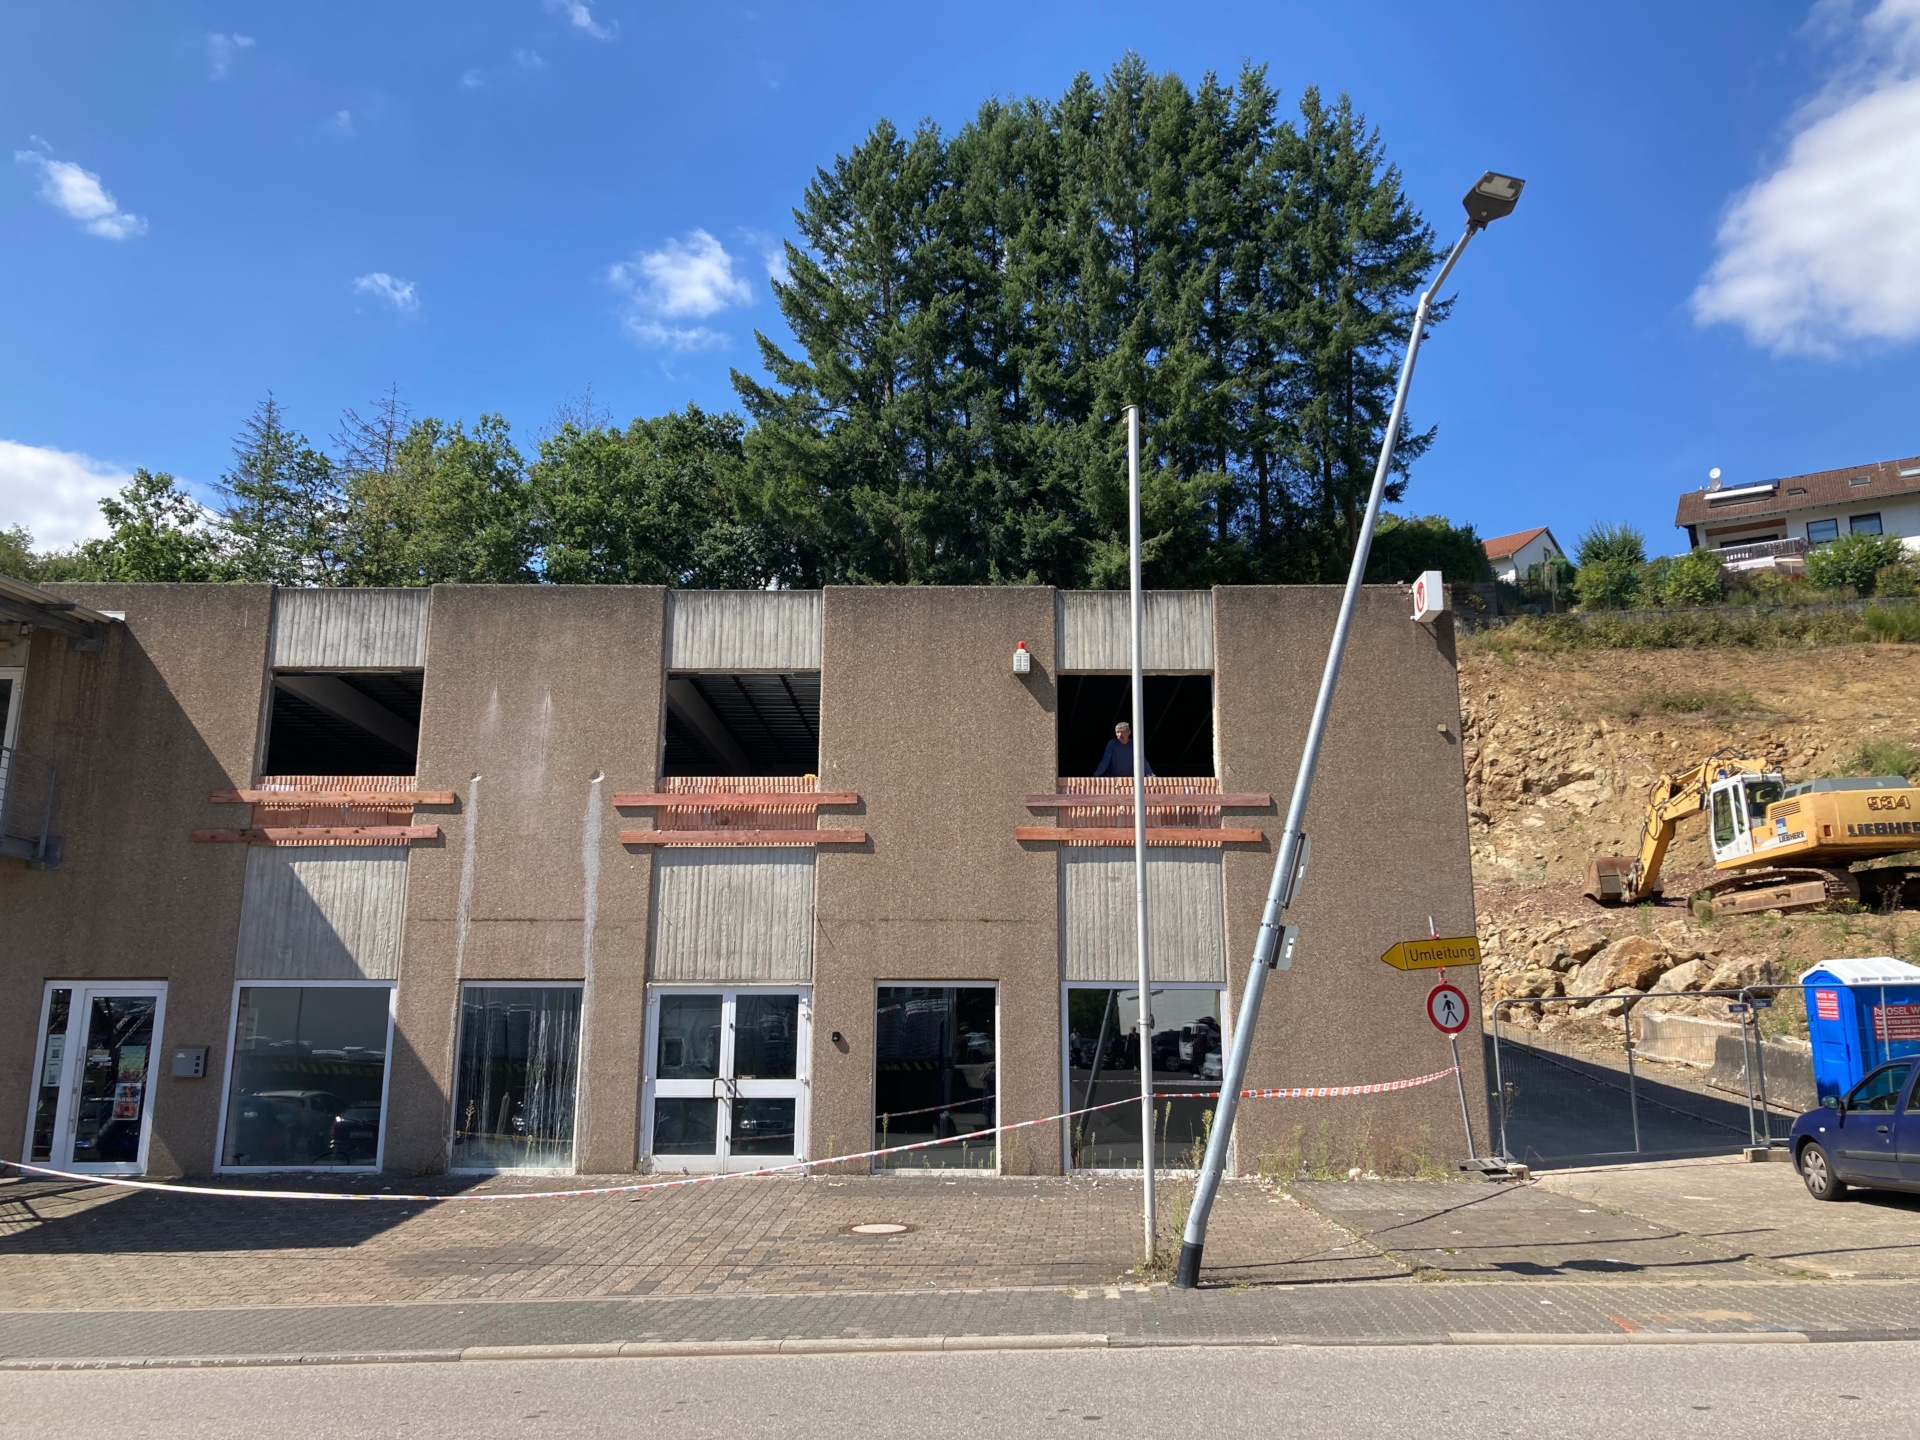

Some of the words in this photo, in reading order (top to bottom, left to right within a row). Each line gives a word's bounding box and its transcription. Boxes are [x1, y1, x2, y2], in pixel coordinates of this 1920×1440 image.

[1867, 795, 1911, 811] 934
[1779, 830, 1805, 843] LIEBHERR
[1408, 946, 1475, 962] Umleitung
